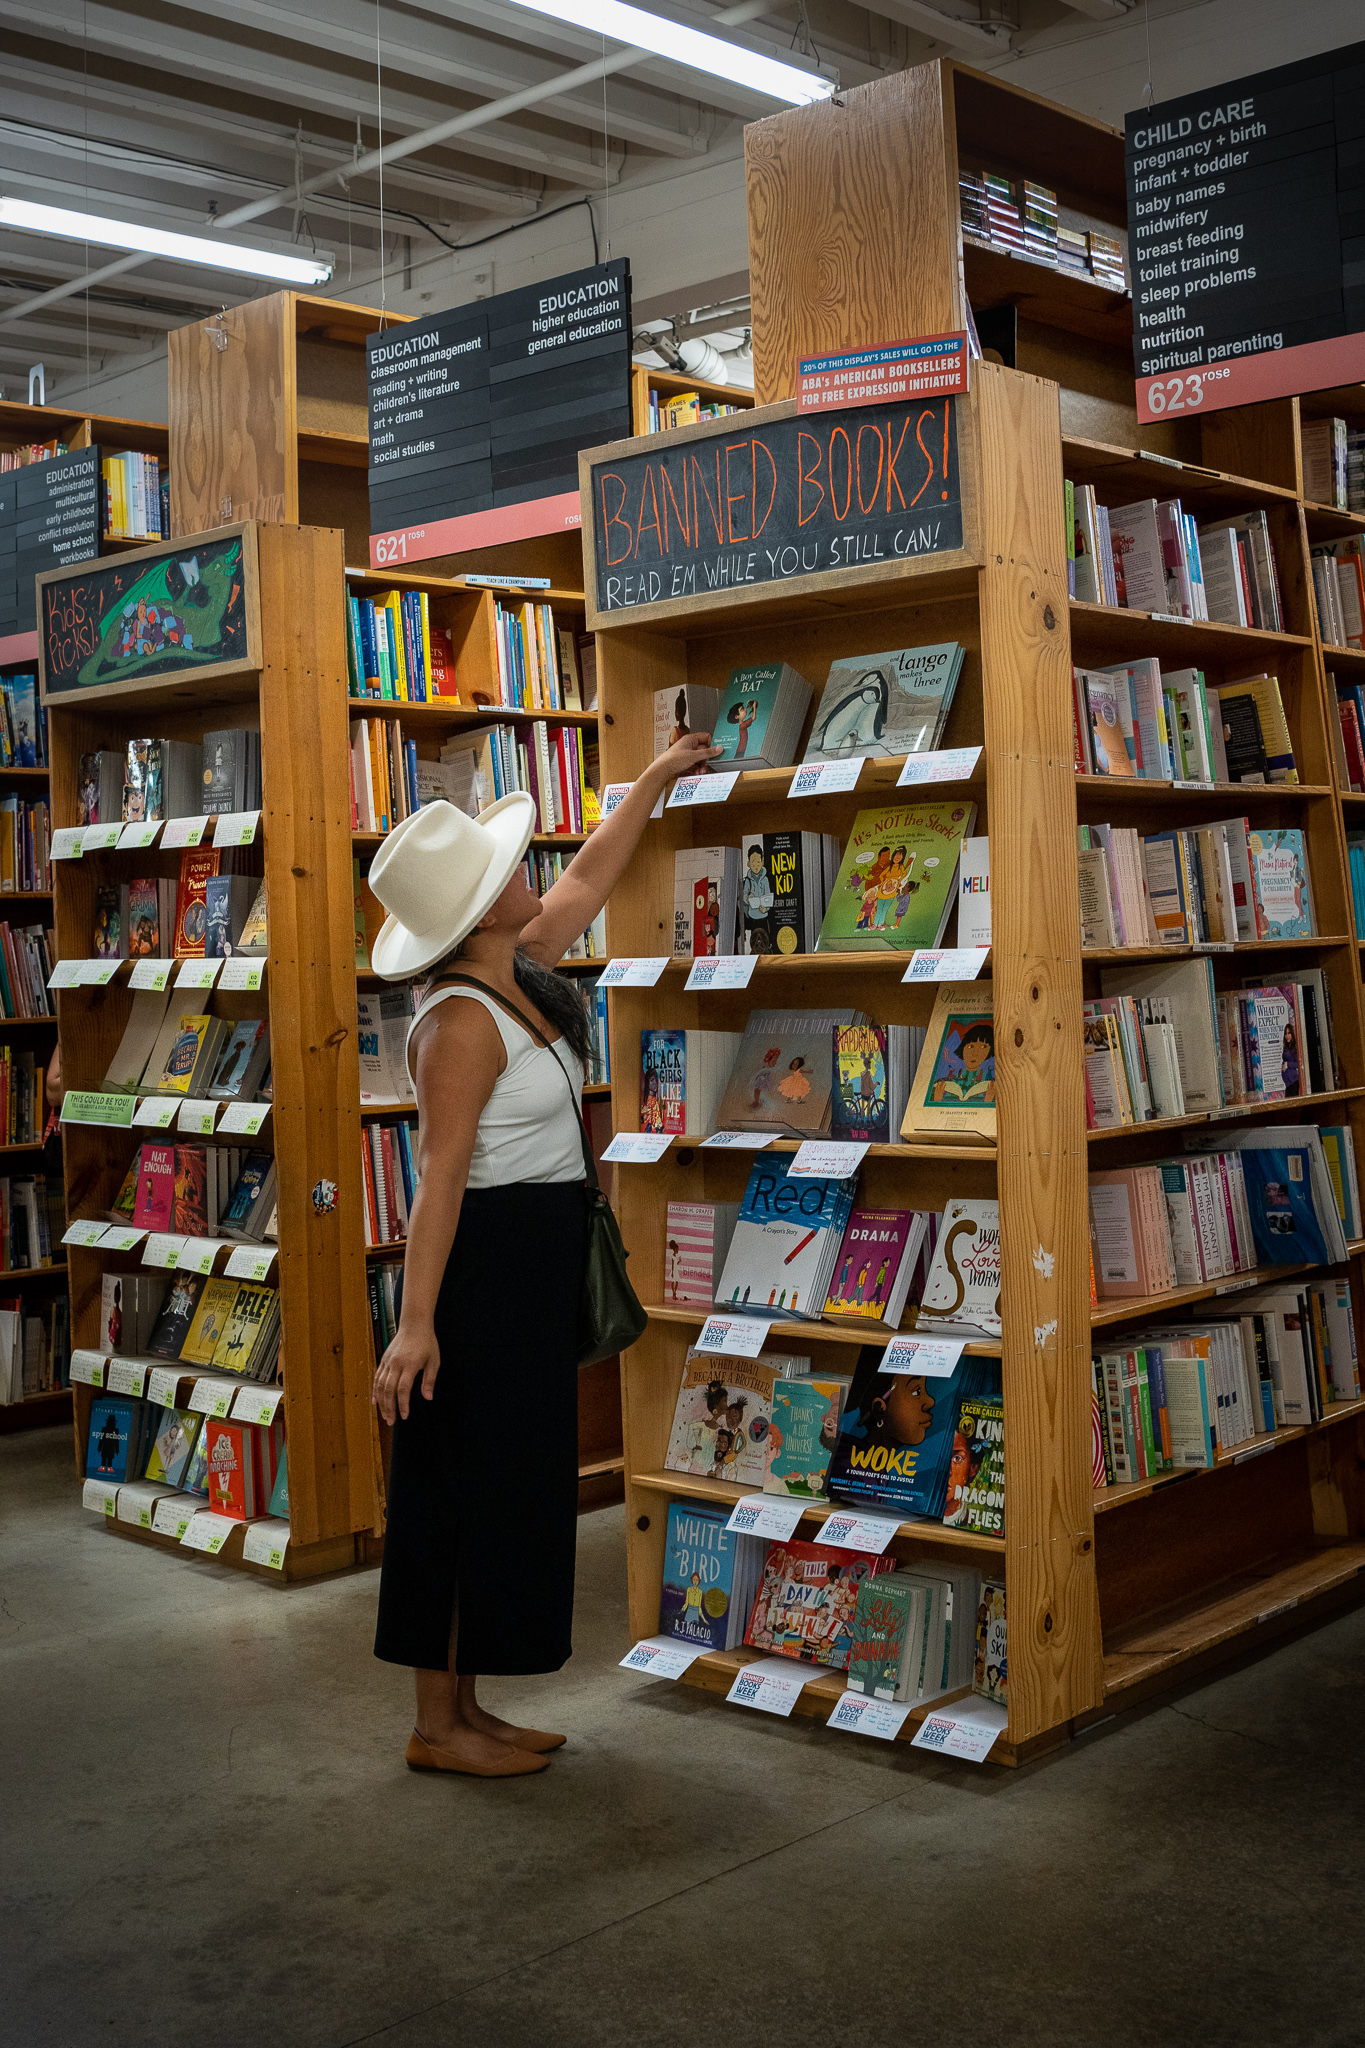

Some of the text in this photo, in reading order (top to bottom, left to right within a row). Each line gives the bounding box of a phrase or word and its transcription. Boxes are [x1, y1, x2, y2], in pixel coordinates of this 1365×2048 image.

[1134, 98, 1254, 149] CHILD CARE
[1134, 139, 1211, 175] pregnancy
[1230, 121, 1266, 144] birth
[1135, 169, 1177, 193] infant
[1194, 152, 1249, 176] toddler
[1136, 182, 1225, 216] baby names
[1136, 209, 1208, 238] midwifery
[1137, 224, 1244, 261] breast feeding
[1140, 248, 1239, 282] toilet training
[539, 277, 618, 314] EDUCATION
[1141, 266, 1256, 304] sleep problems
[533, 300, 619, 332] higher education
[1140, 305, 1186, 328] health
[528, 318, 622, 355] general education
[1142, 325, 1204, 349] nutrition
[371, 332, 439, 364] EDUCATION
[371, 336, 481, 379] classroom management
[804, 364, 816, 372] 20%
[829, 359, 843, 368] THIS
[845, 354, 878, 365] DISPLAY'S
[881, 351, 900, 360] SALES
[902, 348, 919, 356] WILL
[934, 344, 942, 352] TO
[944, 342, 958, 350] THE
[1141, 332, 1283, 374] spiritual parenting
[373, 379, 405, 396] reading
[416, 368, 447, 384] writing
[802, 357, 961, 390] ABA's AMERICAN BOOKSELLERS
[374, 381, 459, 412] children's literature
[802, 373, 961, 405] FOR FREE EXPRESSION INITIATIVE
[1148, 367, 1230, 413] 623 rose
[374, 417, 385, 429] art
[396, 409, 423, 423] drama
[373, 432, 394, 447] math
[374, 441, 435, 463] social studies
[46, 461, 94, 484] EDUCATION
[601, 400, 949, 565] BANNED BOOKS!
[49, 478, 94, 496] administration
[56, 488, 95, 508] multicultural
[46, 504, 94, 525] early childhood
[39, 521, 94, 542] conflict resolution
[53, 533, 94, 553] home school
[376, 529, 425, 563] 621 rose
[60, 549, 94, 564] workbooks
[607, 572, 660, 609] READ
[705, 552, 755, 588] WHILE
[766, 543, 818, 578] YOU
[830, 535, 883, 565] STILL
[895, 522, 941, 554] CAN!
[899, 652, 947, 673] tango
[900, 670, 922, 679] makes
[914, 678, 942, 687] three
[741, 680, 764, 693] BAT
[853, 831, 871, 847] It's
[874, 814, 902, 835] NOT
[904, 814, 923, 827] the
[191, 863, 210, 872] POWER
[771, 852, 795, 875] NEW
[675, 911, 684, 920] GO
[675, 921, 689, 930] WITH
[674, 940, 691, 951] FLOW
[675, 931, 684, 939] THE
[1276, 1005, 1285, 1014] TO
[654, 1040, 664, 1049] FOR
[834, 1029, 886, 1052] SNAPDRAGON
[646, 1049, 680, 1069] BLACK
[660, 1070, 682, 1083] GIRLS
[85, 1096, 104, 1104] COULD
[661, 1083, 681, 1100] LIKE
[667, 1102, 680, 1118] ME
[144, 1161, 172, 1174] ENOUGH
[152, 1151, 166, 1163] NAT
[750, 1174, 829, 1215] Red
[850, 1229, 899, 1242] DRAMA
[1205, 1194, 1218, 1259] PREGNANT!
[791, 1406, 813, 1424] THANKS
[92, 1431, 127, 1440] spy school
[793, 1424, 797, 1435] A
[218, 1439, 229, 1449] ICE
[786, 1433, 812, 1454] UNIVERSE
[210, 1459, 237, 1472] MACHINE
[851, 1445, 919, 1476] WOKE
[968, 1509, 1001, 1529] FLIES
[676, 1516, 727, 1551] WHITE
[679, 1550, 720, 1583] BIRD
[805, 1563, 826, 1575] THIS
[787, 1585, 812, 1601] DAY
[861, 1599, 902, 1637] Lily
[854, 1641, 900, 1661] DUNKIN
[926, 1725, 952, 1736] BOOKS
[930, 1718, 955, 1729] BANNED
[923, 1732, 948, 1742] WEEK
